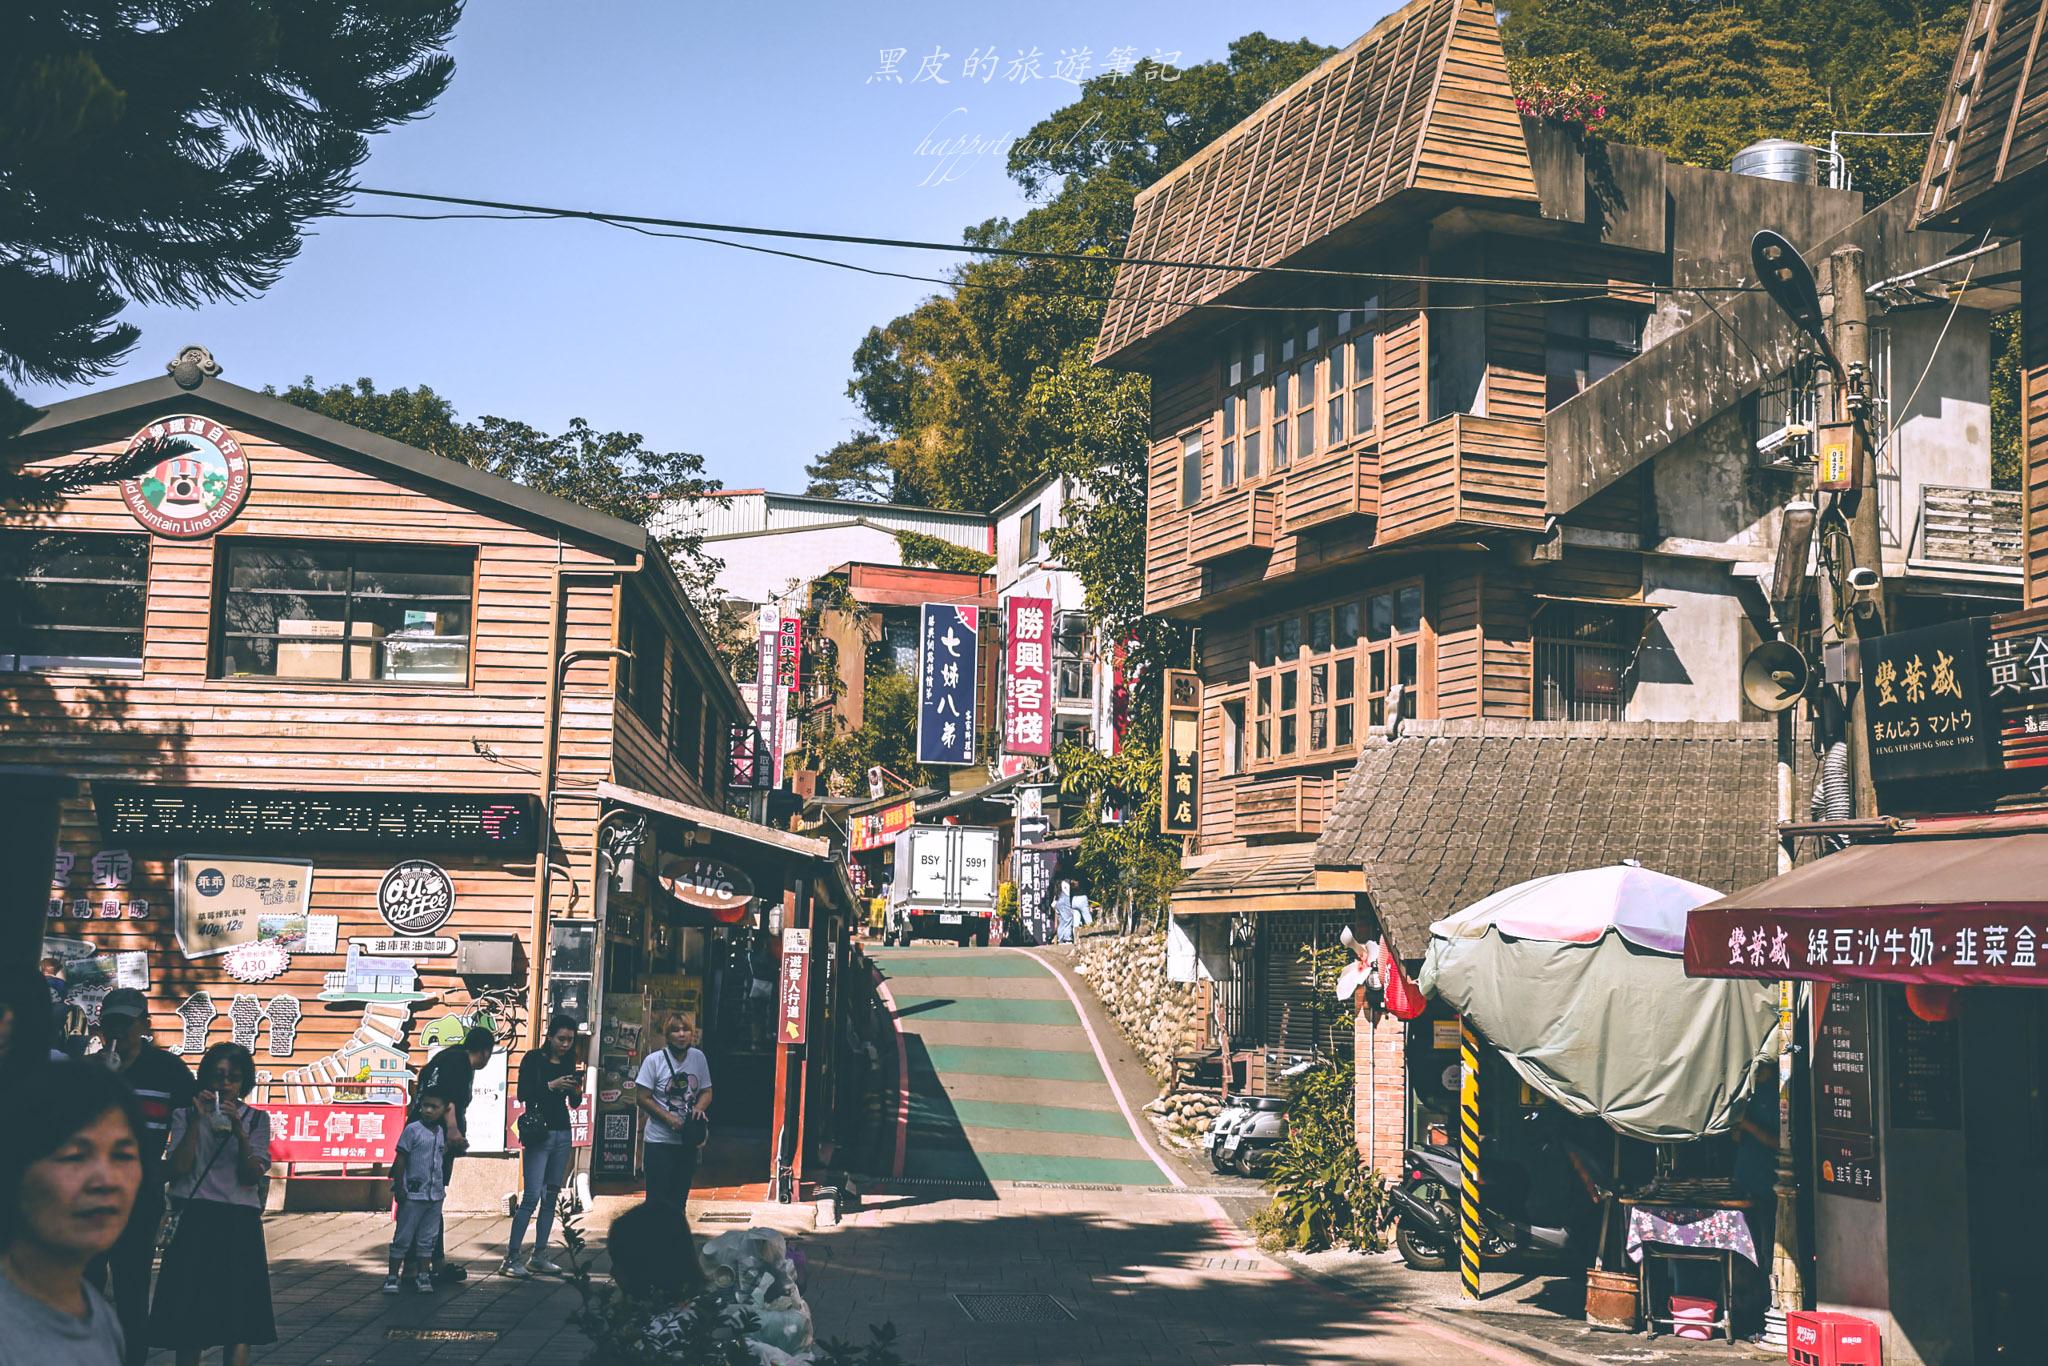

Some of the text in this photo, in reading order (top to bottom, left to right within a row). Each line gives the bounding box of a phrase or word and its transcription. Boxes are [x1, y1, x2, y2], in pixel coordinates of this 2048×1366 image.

[132, 417, 245, 473] 山線鐵道自行車
[130, 494, 181, 533] Mountain
[183, 515, 212, 533] Line
[209, 501, 233, 523] Rail
[226, 475, 244, 503] bike
[1015, 607, 1044, 745] 勝興客棧
[1873, 709, 1972, 742] まんじゅう マントウ
[1909, 740, 1934, 751] SHENG
[1934, 738, 1955, 748] Since
[1956, 735, 1975, 745] 1995
[921, 855, 987, 868] BSY 5991
[198, 875, 223, 890] 乖乖
[693, 876, 735, 900] WC
[241, 960, 266, 972] 430
[786, 955, 802, 1018] 遊客人行道
[269, 1110, 385, 1143] 禁止停車
